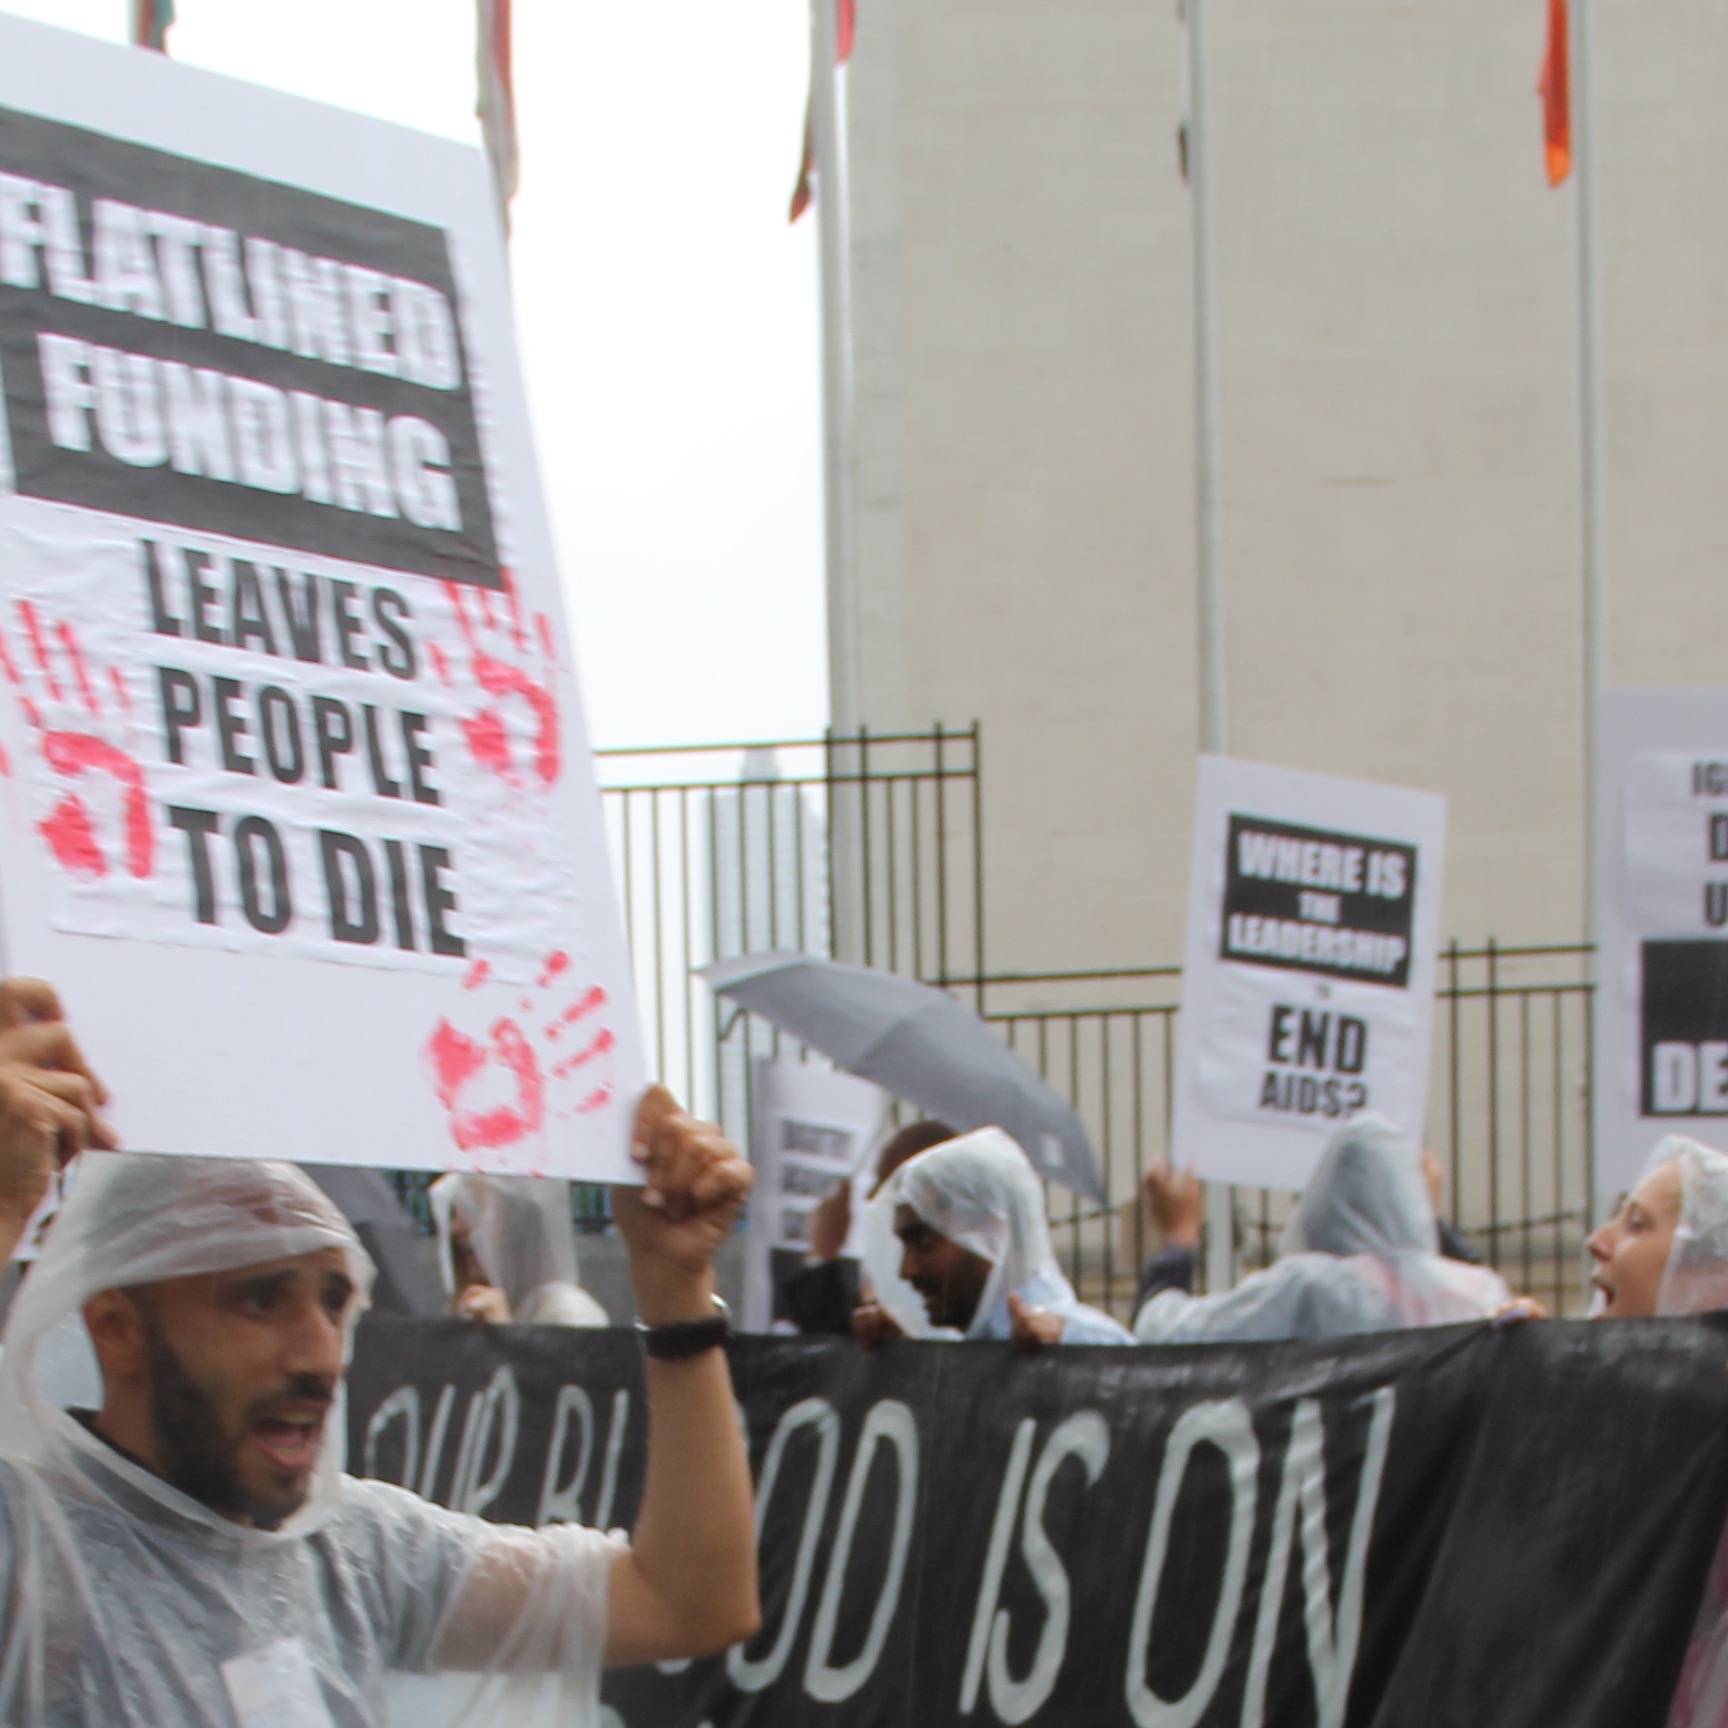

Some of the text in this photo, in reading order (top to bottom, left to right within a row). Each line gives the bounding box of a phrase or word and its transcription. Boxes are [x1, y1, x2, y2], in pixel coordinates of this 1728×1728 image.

[38, 332, 461, 531] FUNDING
[142, 538, 417, 680] LEAVES
[156, 666, 442, 805] PEOPLE
[164, 805, 468, 959] TO DIE
[1238, 829, 1408, 899] WHERE IS
[1228, 912, 1408, 975] LEADERSHIP
[1259, 1070, 1368, 1119] AIDS?
[1269, 1003, 1368, 1074] END
[961, 1417, 1110, 1725] IS
